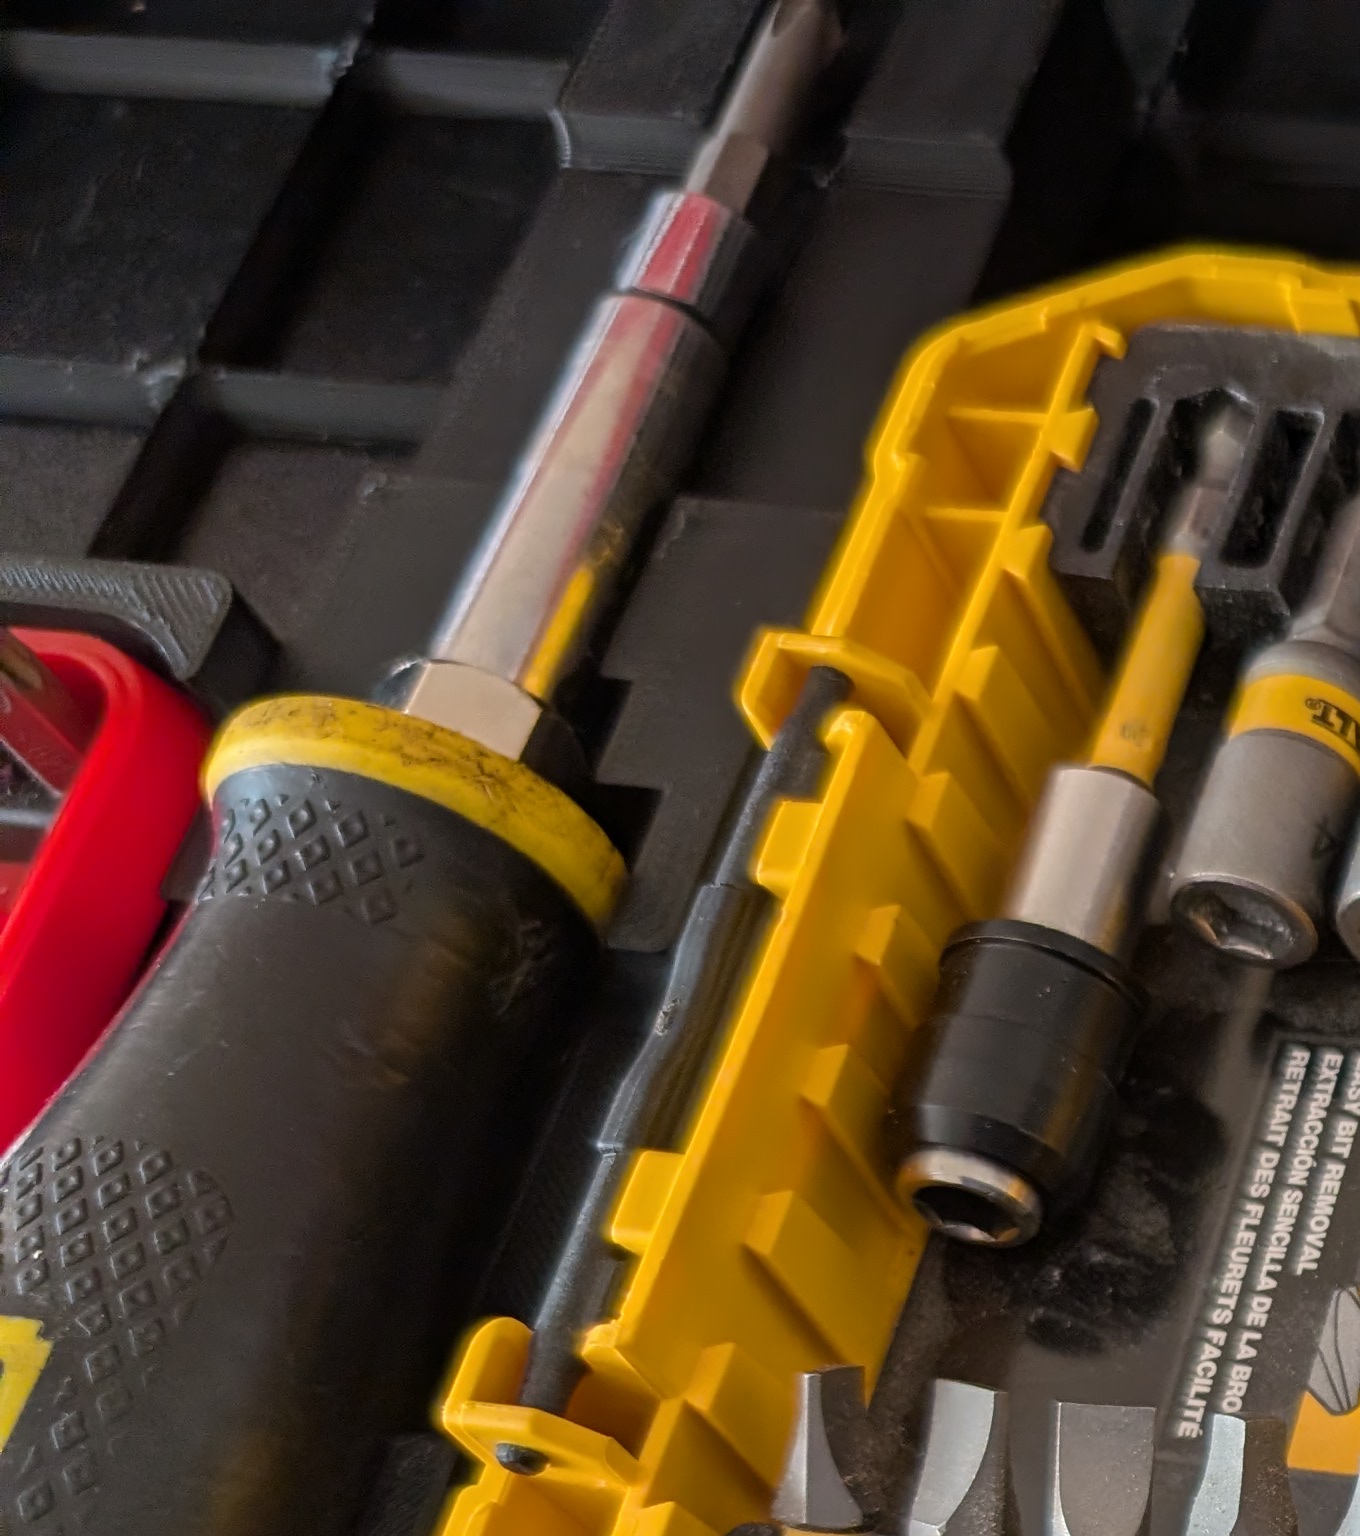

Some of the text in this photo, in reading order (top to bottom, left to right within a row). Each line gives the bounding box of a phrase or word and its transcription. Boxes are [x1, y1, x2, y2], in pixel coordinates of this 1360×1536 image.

[1178, 1049, 1310, 1439] RETRAIT DES FLEURETS FACILITÉ
[1221, 1052, 1344, 1414] EXTRACCIÓN SENCILLA DE LA BRO
[1297, 1163, 1346, 1276] REMOVAL
[1331, 1120, 1358, 1159] BIT
